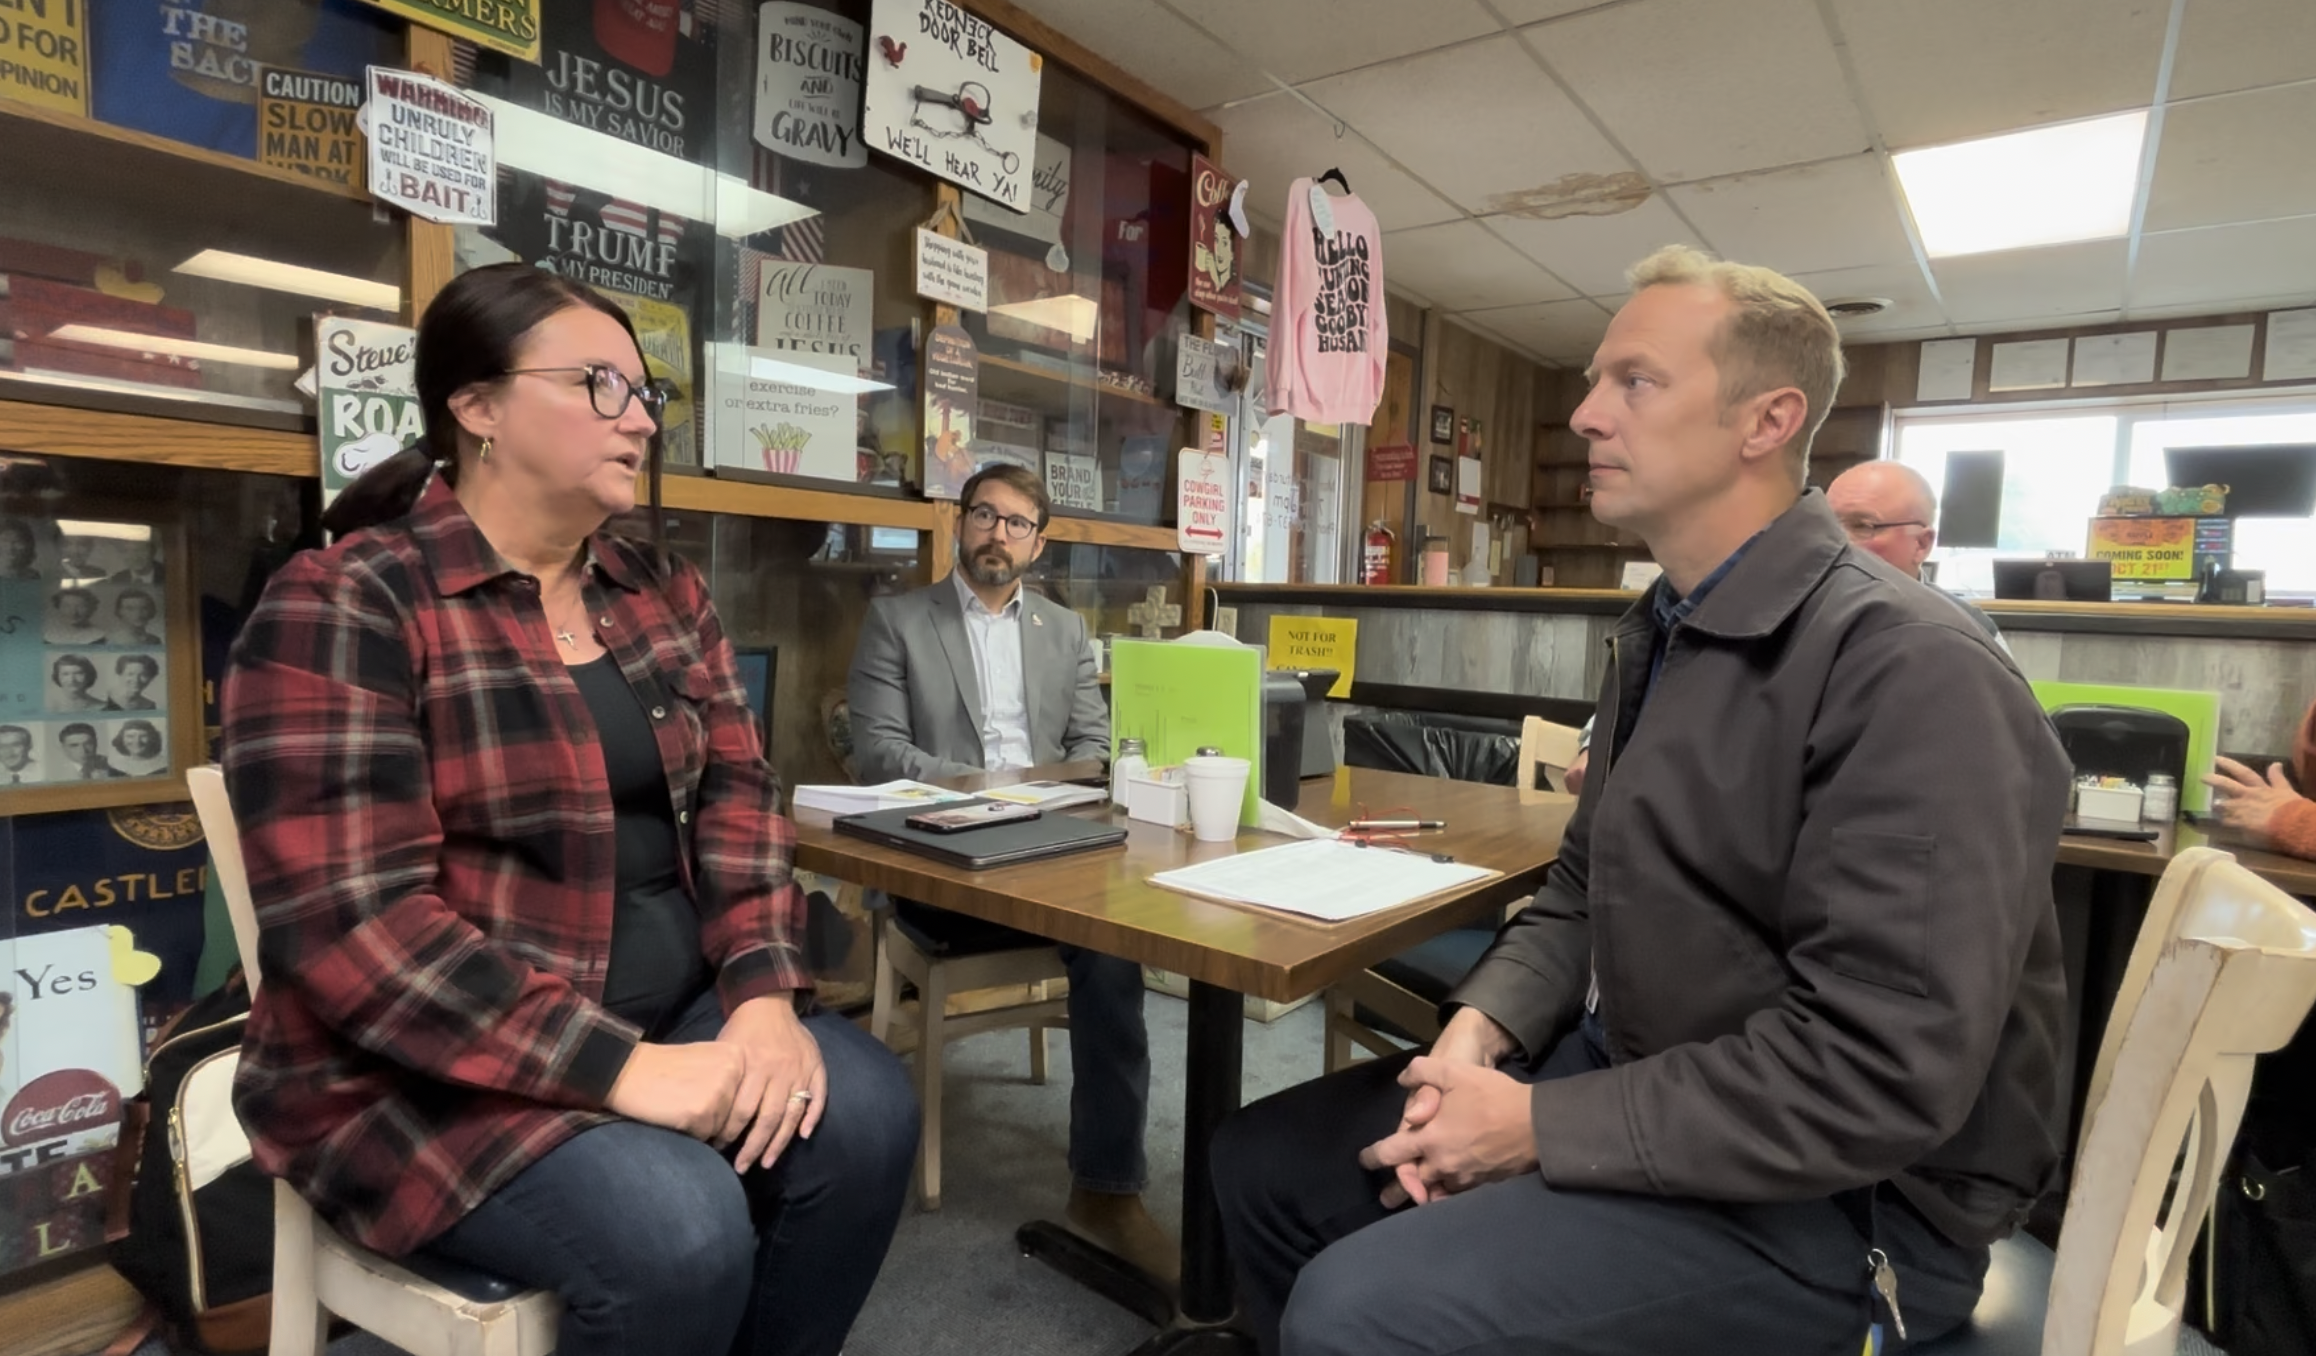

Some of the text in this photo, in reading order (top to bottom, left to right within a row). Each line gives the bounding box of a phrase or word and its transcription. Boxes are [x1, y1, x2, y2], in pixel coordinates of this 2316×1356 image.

[18, 22, 78, 66] FOR
[160, 4, 247, 52] THE
[919, 11, 999, 72] DOOR BELL
[170, 41, 259, 86] BAC
[770, 33, 862, 83] BISCUITS
[266, 72, 359, 107] CAUTION
[376, 73, 488, 129] WARNING
[547, 50, 685, 132] JESUS
[801, 79, 833, 94] AND
[268, 102, 357, 137] SLOW
[391, 103, 476, 147] UNRULY
[544, 89, 685, 158] IS MY SAVIOR
[771, 111, 854, 158] GRAVY
[266, 131, 356, 165] MAN AT
[378, 123, 488, 174] CHILDREN
[886, 126, 931, 166] WE'LL
[945, 150, 981, 186] HEAR
[379, 148, 486, 190] WILL BE USED FOR
[401, 173, 470, 213] BAIT
[1118, 220, 1143, 242] For
[1312, 227, 1368, 265] HELLO
[589, 266, 673, 300] PRESIDEN
[815, 291, 851, 308] TODAY
[785, 312, 846, 333] COFFEE
[328, 329, 417, 376] Steve'
[750, 381, 816, 397] exercise
[724, 397, 839, 418] or extra fries?
[1051, 465, 1091, 484] BRAND
[1051, 481, 1081, 500] YOUR
[1184, 479, 1224, 497] COWGIRL
[1183, 495, 1225, 512] PARKING
[1192, 511, 1217, 525] ONLY
[2096, 550, 2184, 561] COMING SOON!
[1288, 630, 1336, 643] NOT FOR
[15, 964, 98, 1000] Yes
[62, 1162, 103, 1201] A
[33, 1222, 71, 1257] L
